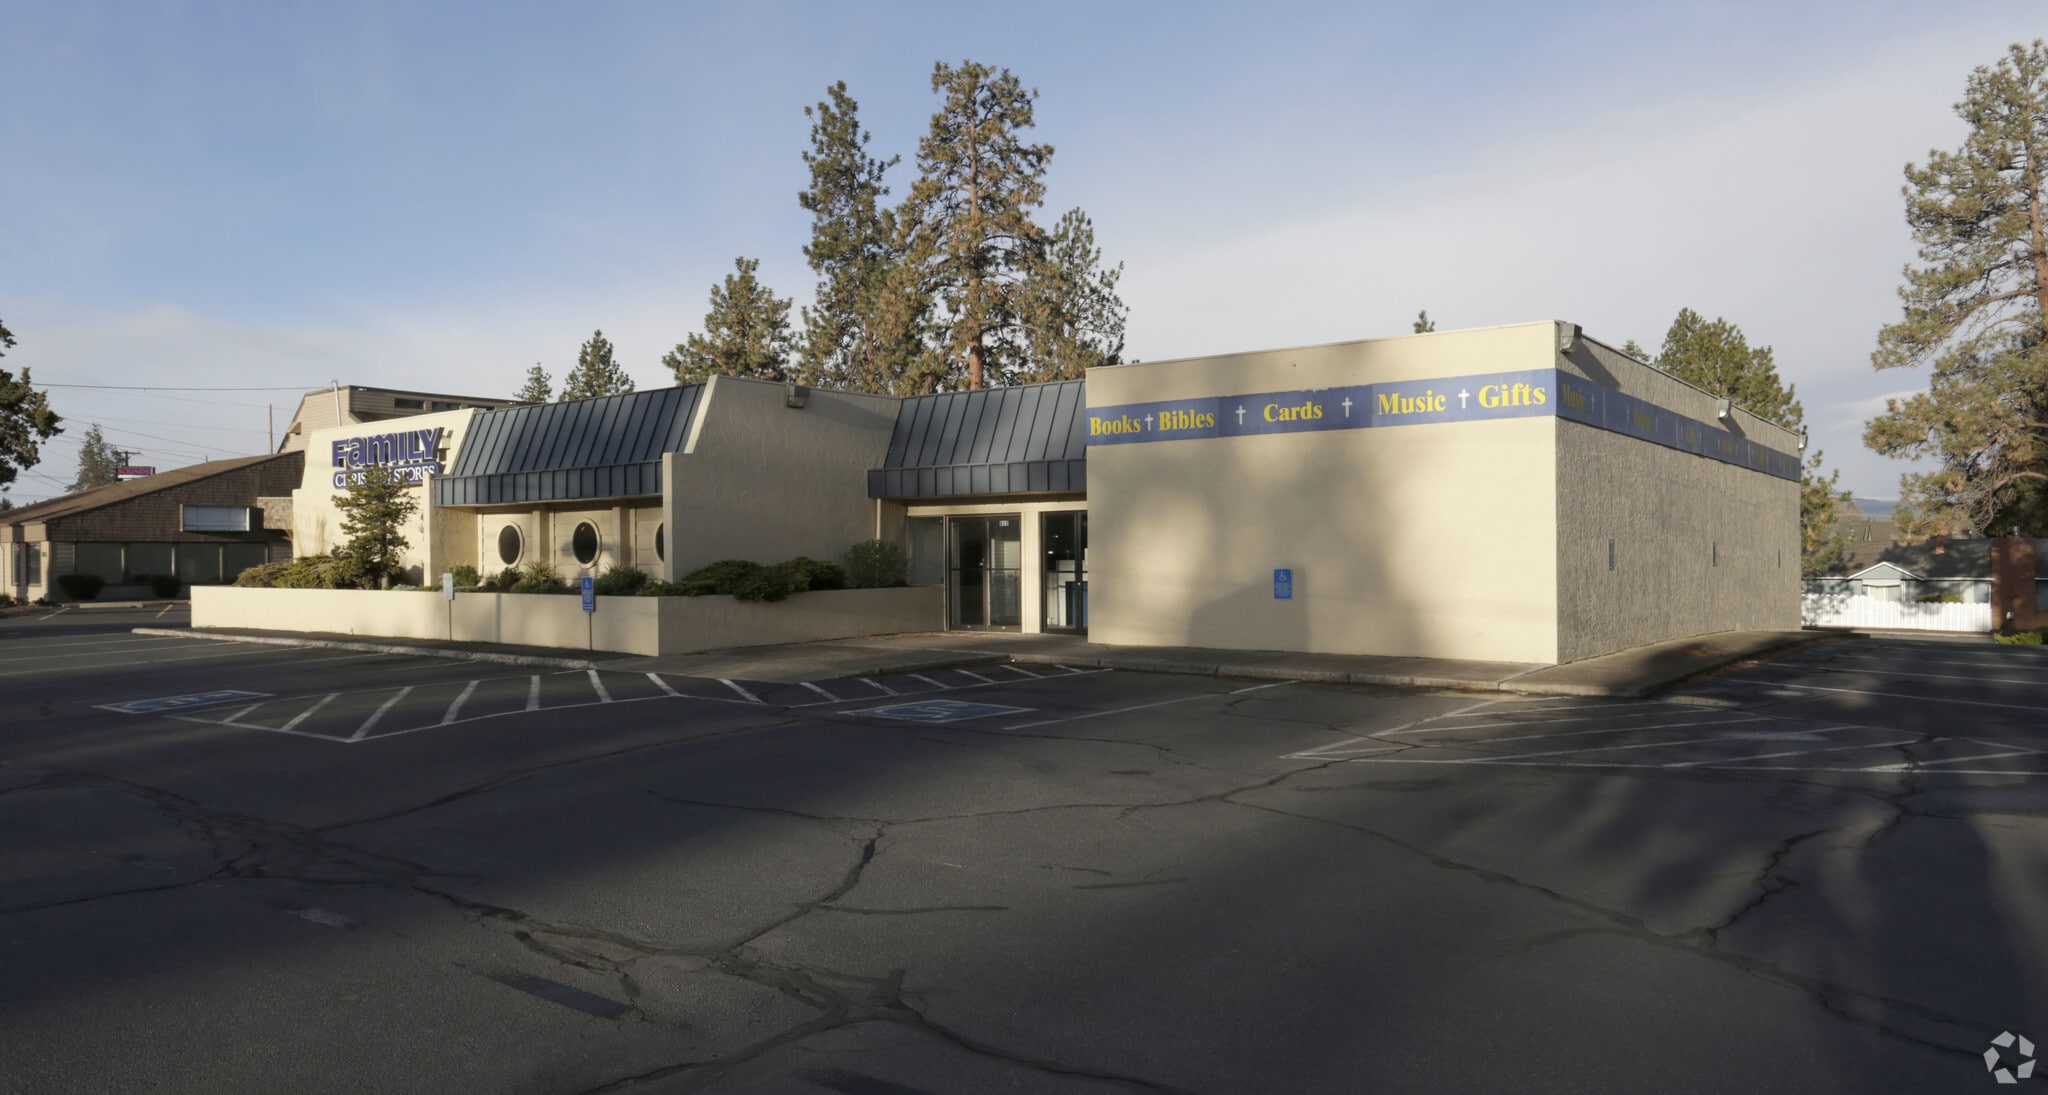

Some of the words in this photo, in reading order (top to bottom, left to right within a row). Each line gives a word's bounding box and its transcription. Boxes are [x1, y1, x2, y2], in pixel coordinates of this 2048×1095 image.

[1090, 415, 1141, 436] Books
[1159, 409, 1215, 431] Bibles
[1263, 401, 1323, 423] Cards
[1378, 390, 1447, 416] Music
[1478, 383, 1547, 409] Gifts
